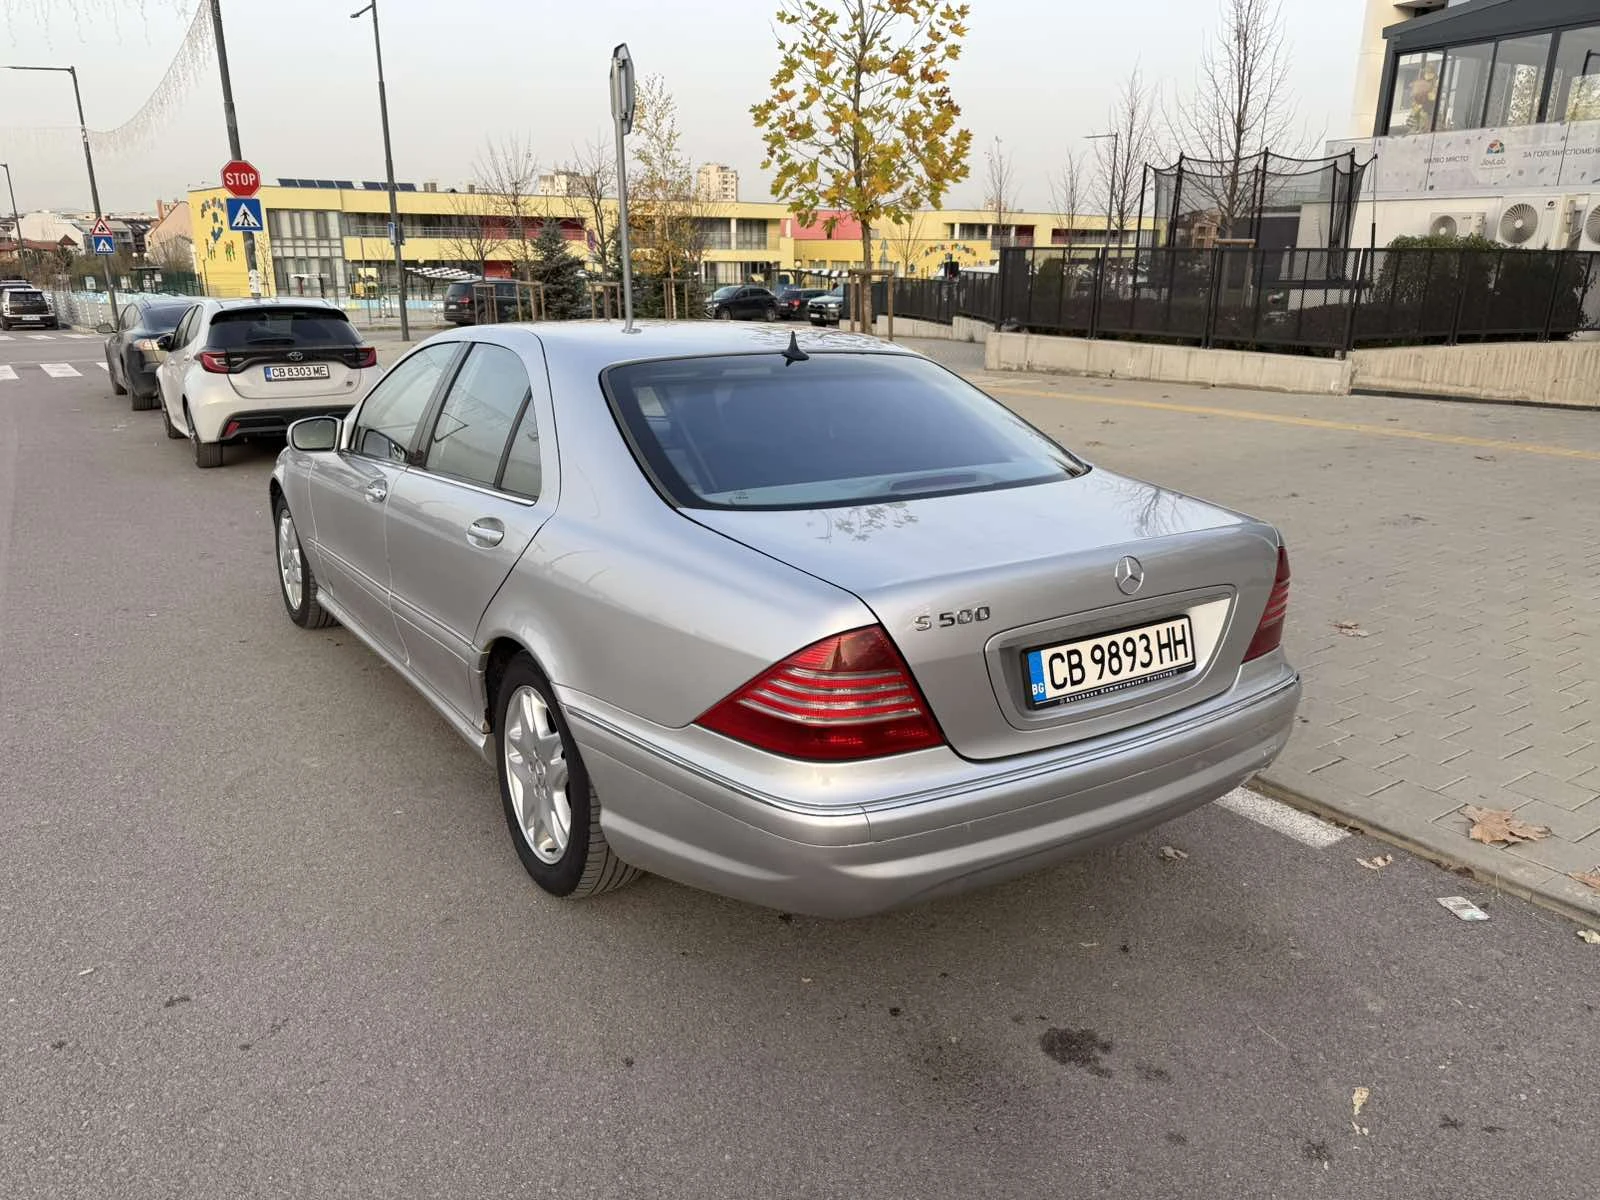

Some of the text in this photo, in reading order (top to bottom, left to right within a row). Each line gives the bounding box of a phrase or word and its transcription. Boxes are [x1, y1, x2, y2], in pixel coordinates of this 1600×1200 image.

[225, 172, 256, 186] STOP
[272, 367, 286, 378] CB
[287, 366, 311, 377] 8303
[913, 606, 990, 632] S 500
[1048, 624, 1189, 690] CB 9893 HH
[1032, 682, 1045, 695] BG
